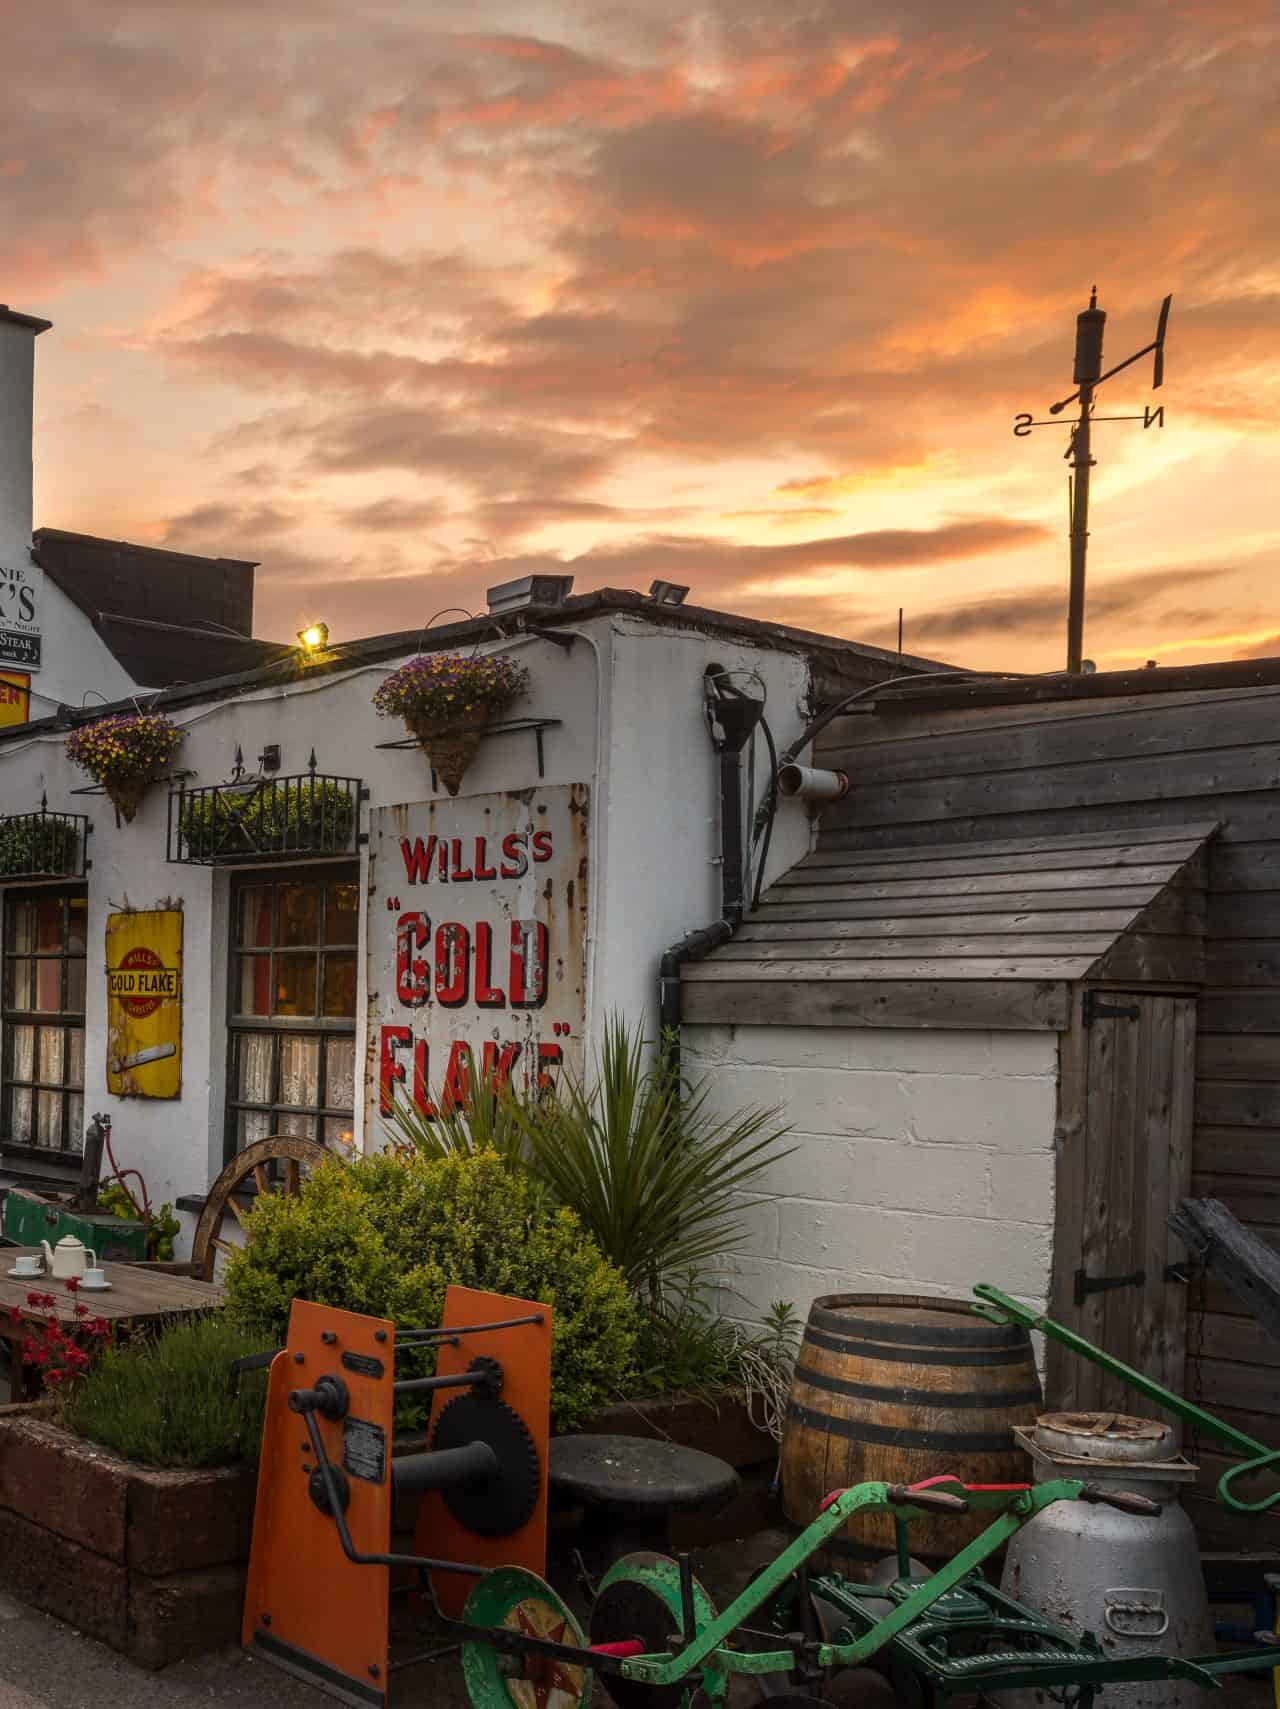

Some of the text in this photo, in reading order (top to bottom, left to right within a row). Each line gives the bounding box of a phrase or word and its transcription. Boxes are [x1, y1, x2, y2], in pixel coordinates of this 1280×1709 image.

[0, 632, 33, 650] STEAK
[111, 974, 174, 992] GOLD FLAKE
